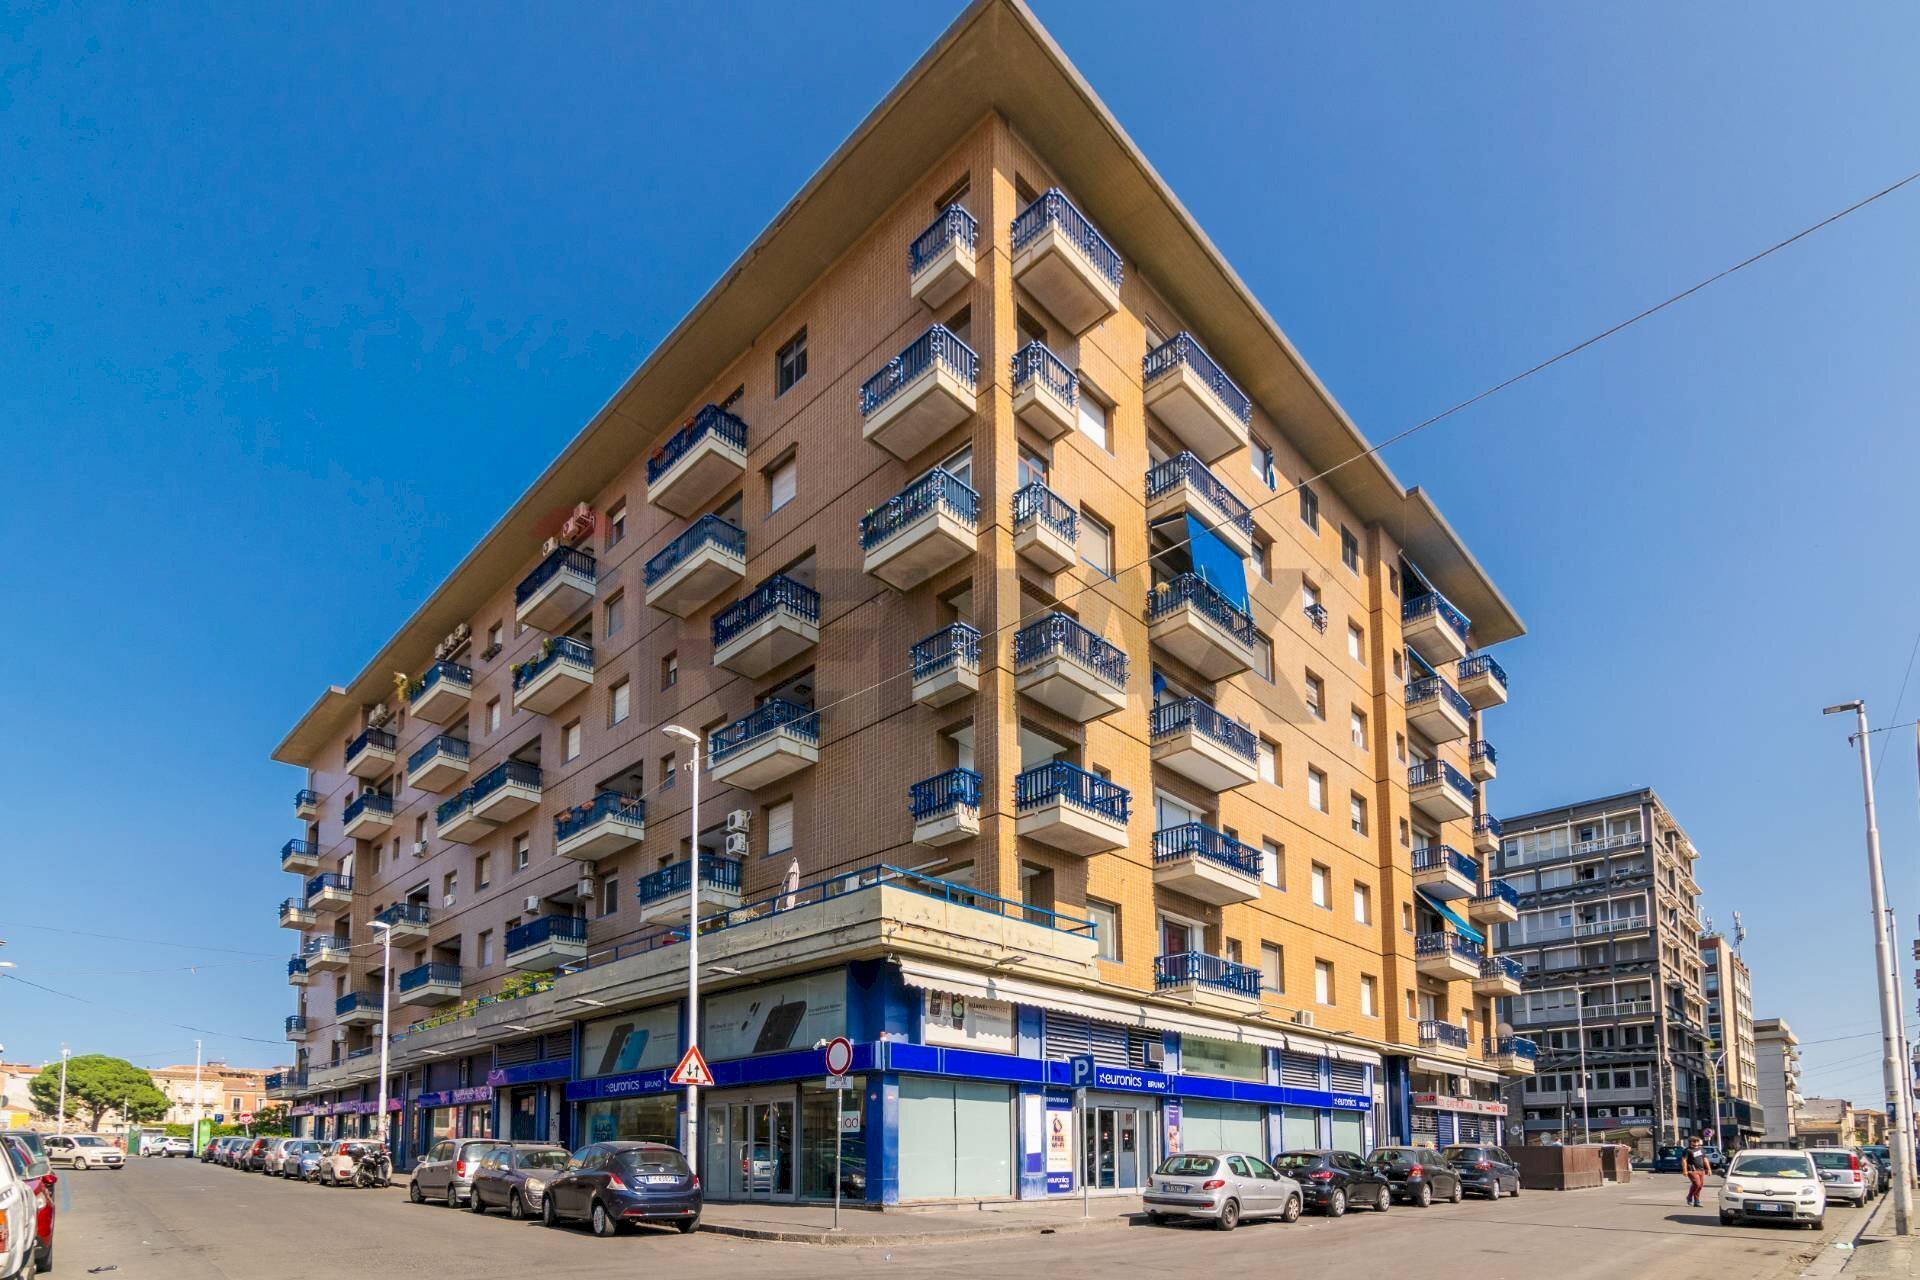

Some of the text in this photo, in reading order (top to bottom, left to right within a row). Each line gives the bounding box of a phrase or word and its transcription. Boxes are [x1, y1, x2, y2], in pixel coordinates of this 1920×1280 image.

[1075, 1059, 1089, 1085] P
[1105, 1072, 1143, 1088] euronics
[608, 1078, 640, 1094] euronics
